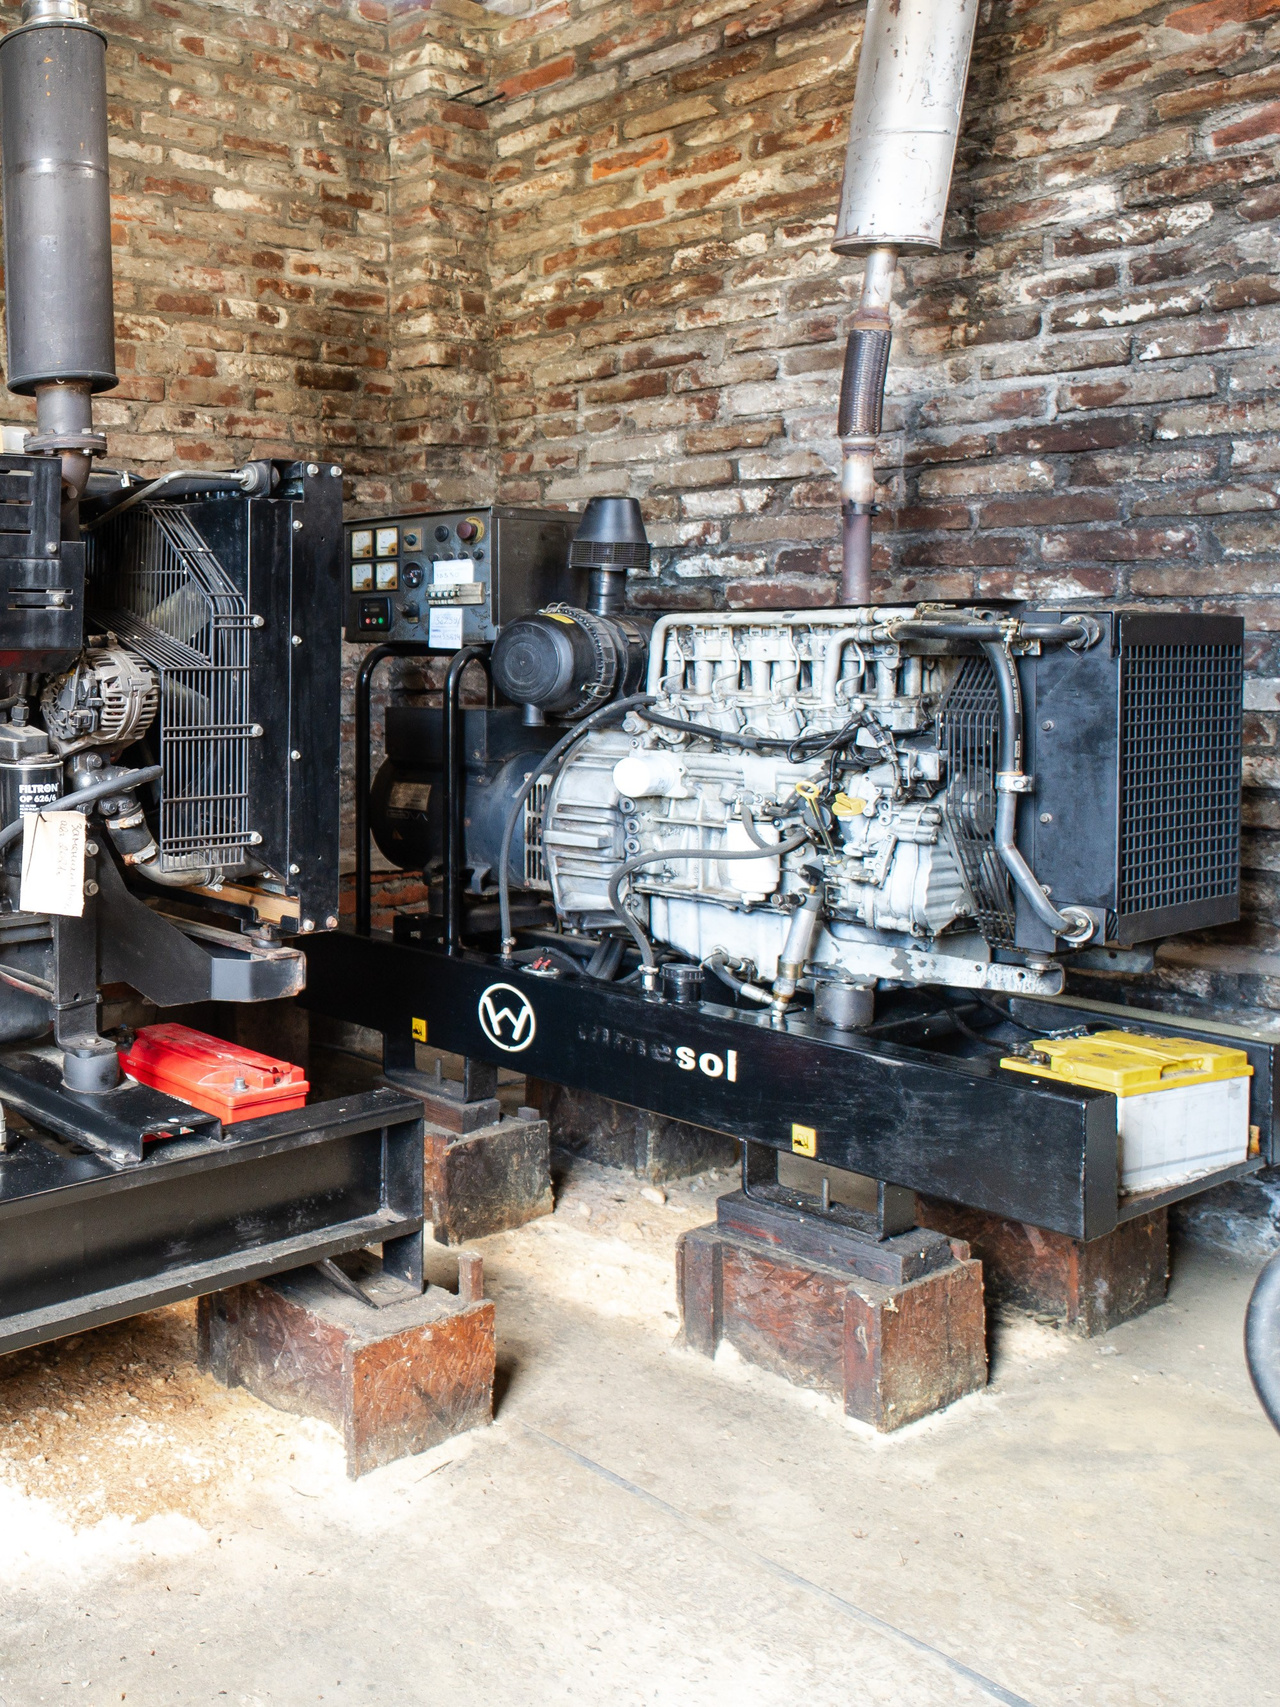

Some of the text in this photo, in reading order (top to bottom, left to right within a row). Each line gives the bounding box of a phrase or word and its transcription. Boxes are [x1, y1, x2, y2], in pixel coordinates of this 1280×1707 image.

[19, 783, 58, 794] FILTRON
[19, 794, 57, 803] OP 626/6
